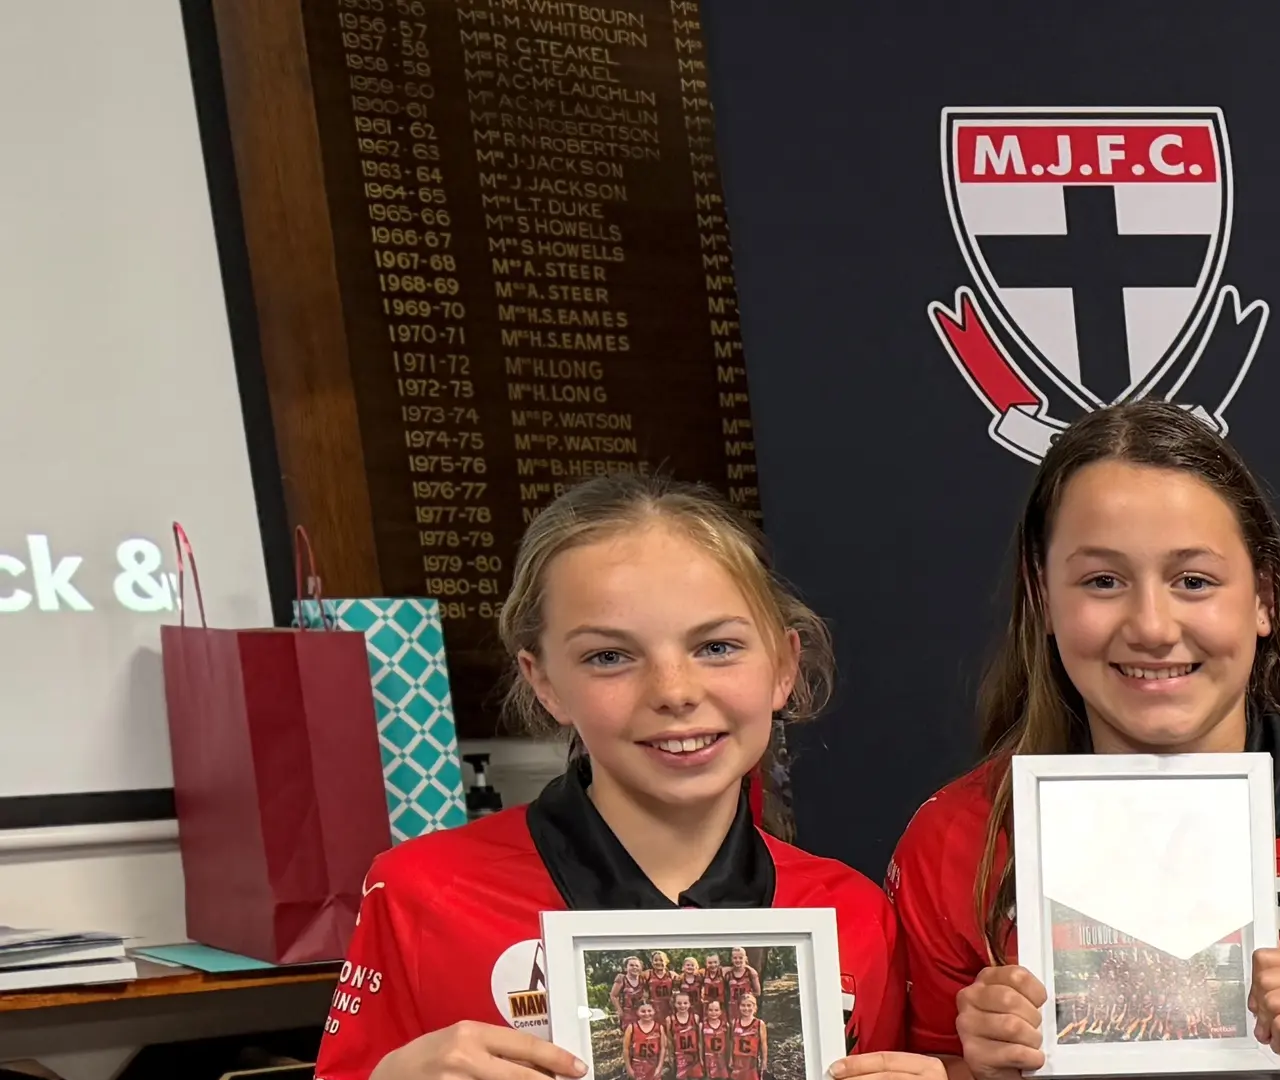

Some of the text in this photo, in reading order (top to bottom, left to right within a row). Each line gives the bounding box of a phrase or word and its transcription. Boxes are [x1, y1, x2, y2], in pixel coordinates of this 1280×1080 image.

[973, 134, 1203, 175] M.J.F.C.
[368, 203, 451, 227] 1965-66
[371, 225, 452, 248] 1966-67
[374, 249, 456, 272] 1967-68
[545, 262, 607, 282] STEER
[379, 273, 459, 295] 1968-69
[548, 285, 609, 304] STEER
[383, 298, 465, 320] 1969-70
[388, 324, 465, 344] 1970-71
[393, 350, 470, 375] 1971-72
[397, 378, 475, 398] 1972-73
[401, 405, 480, 425] 1973-74
[405, 430, 484, 450] 1974-75
[409, 455, 487, 474] 1975-76
[413, 481, 487, 500] 1976-77
[416, 505, 492, 524] 1977-78
[419, 530, 494, 547] 1978-79
[423, 555, 502, 572] 1979-80
[113, 538, 177, 612] &
[426, 578, 499, 595] 1980-81
[439, 602, 504, 620] 981-82
